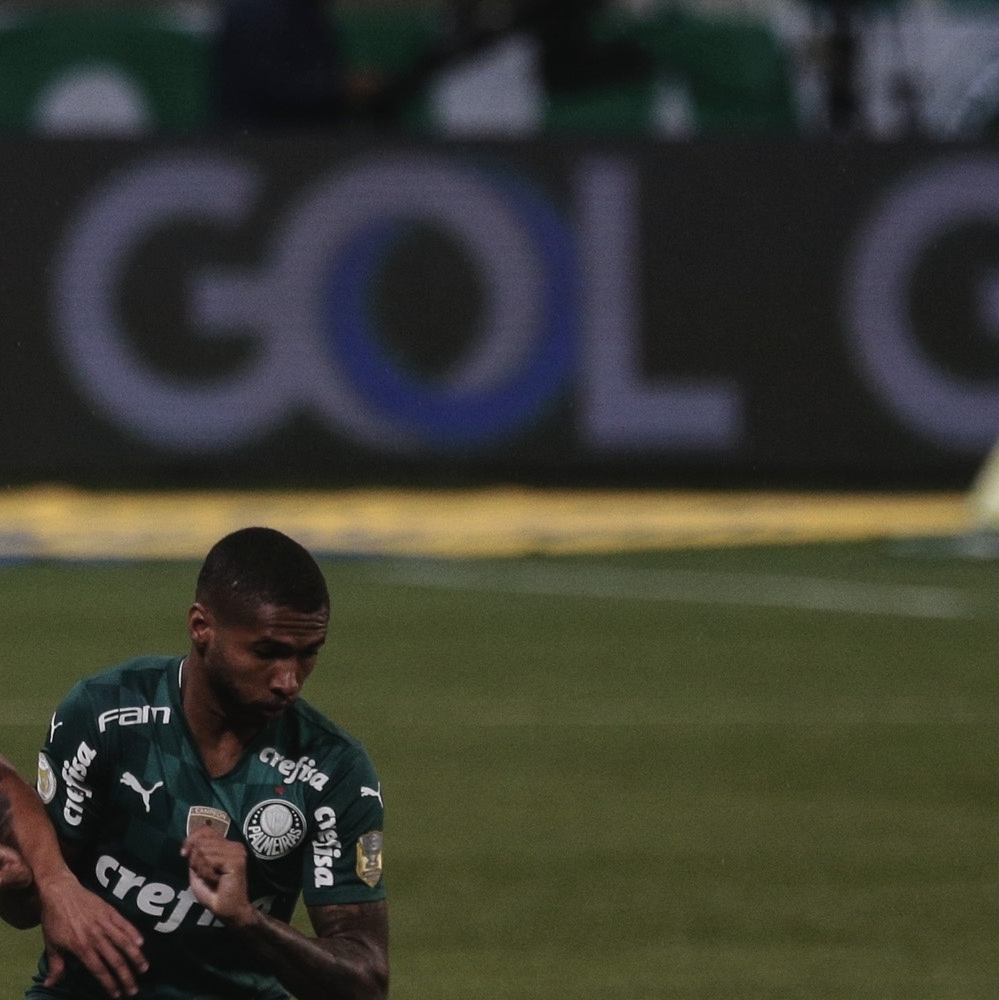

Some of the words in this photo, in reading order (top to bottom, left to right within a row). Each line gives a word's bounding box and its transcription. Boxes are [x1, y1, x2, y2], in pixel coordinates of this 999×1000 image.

[49, 150, 741, 453] GOL
[63, 741, 97, 827] crefisa
[259, 747, 329, 792] crefisa
[248, 825, 302, 857] PALMEIRAS
[313, 806, 343, 889] crefisa
